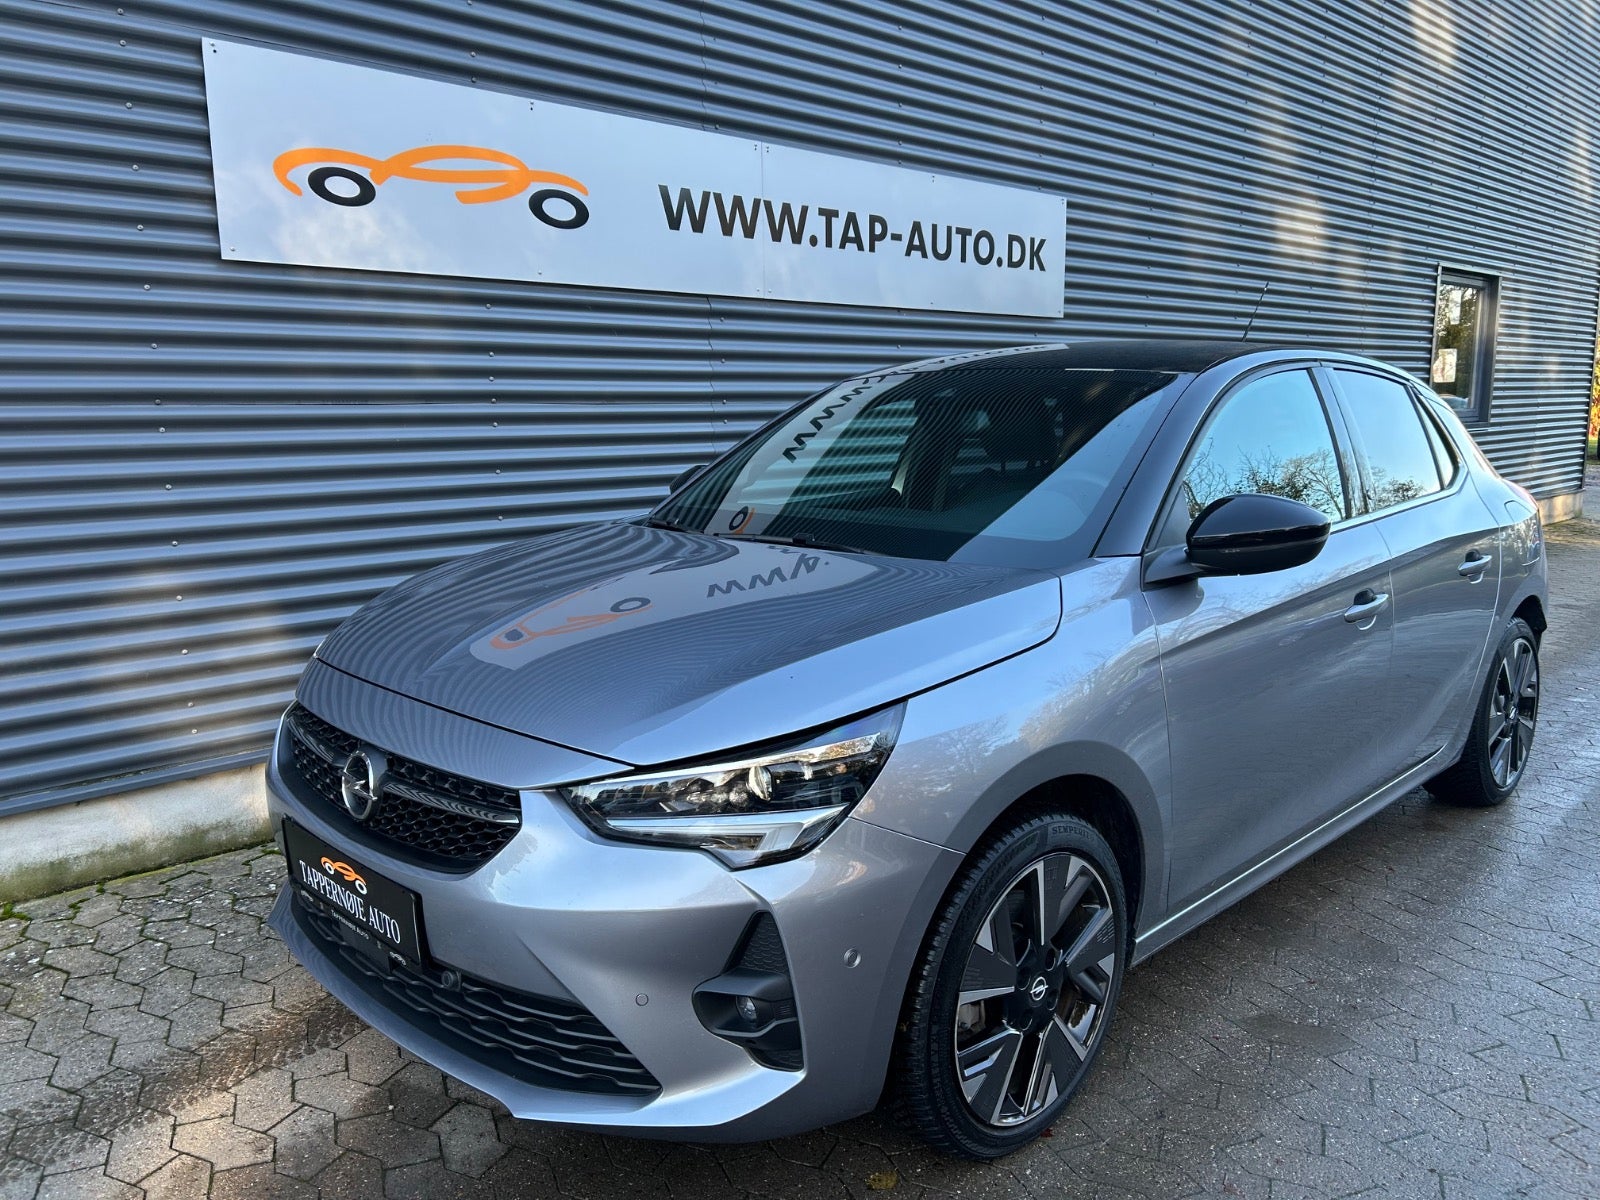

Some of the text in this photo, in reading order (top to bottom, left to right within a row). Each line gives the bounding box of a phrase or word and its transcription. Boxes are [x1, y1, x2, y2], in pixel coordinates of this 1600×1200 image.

[658, 184, 1047, 271] WWW.TAP-AUTO.DK
[299, 859, 401, 944] TAPPERNØJE AUTO
